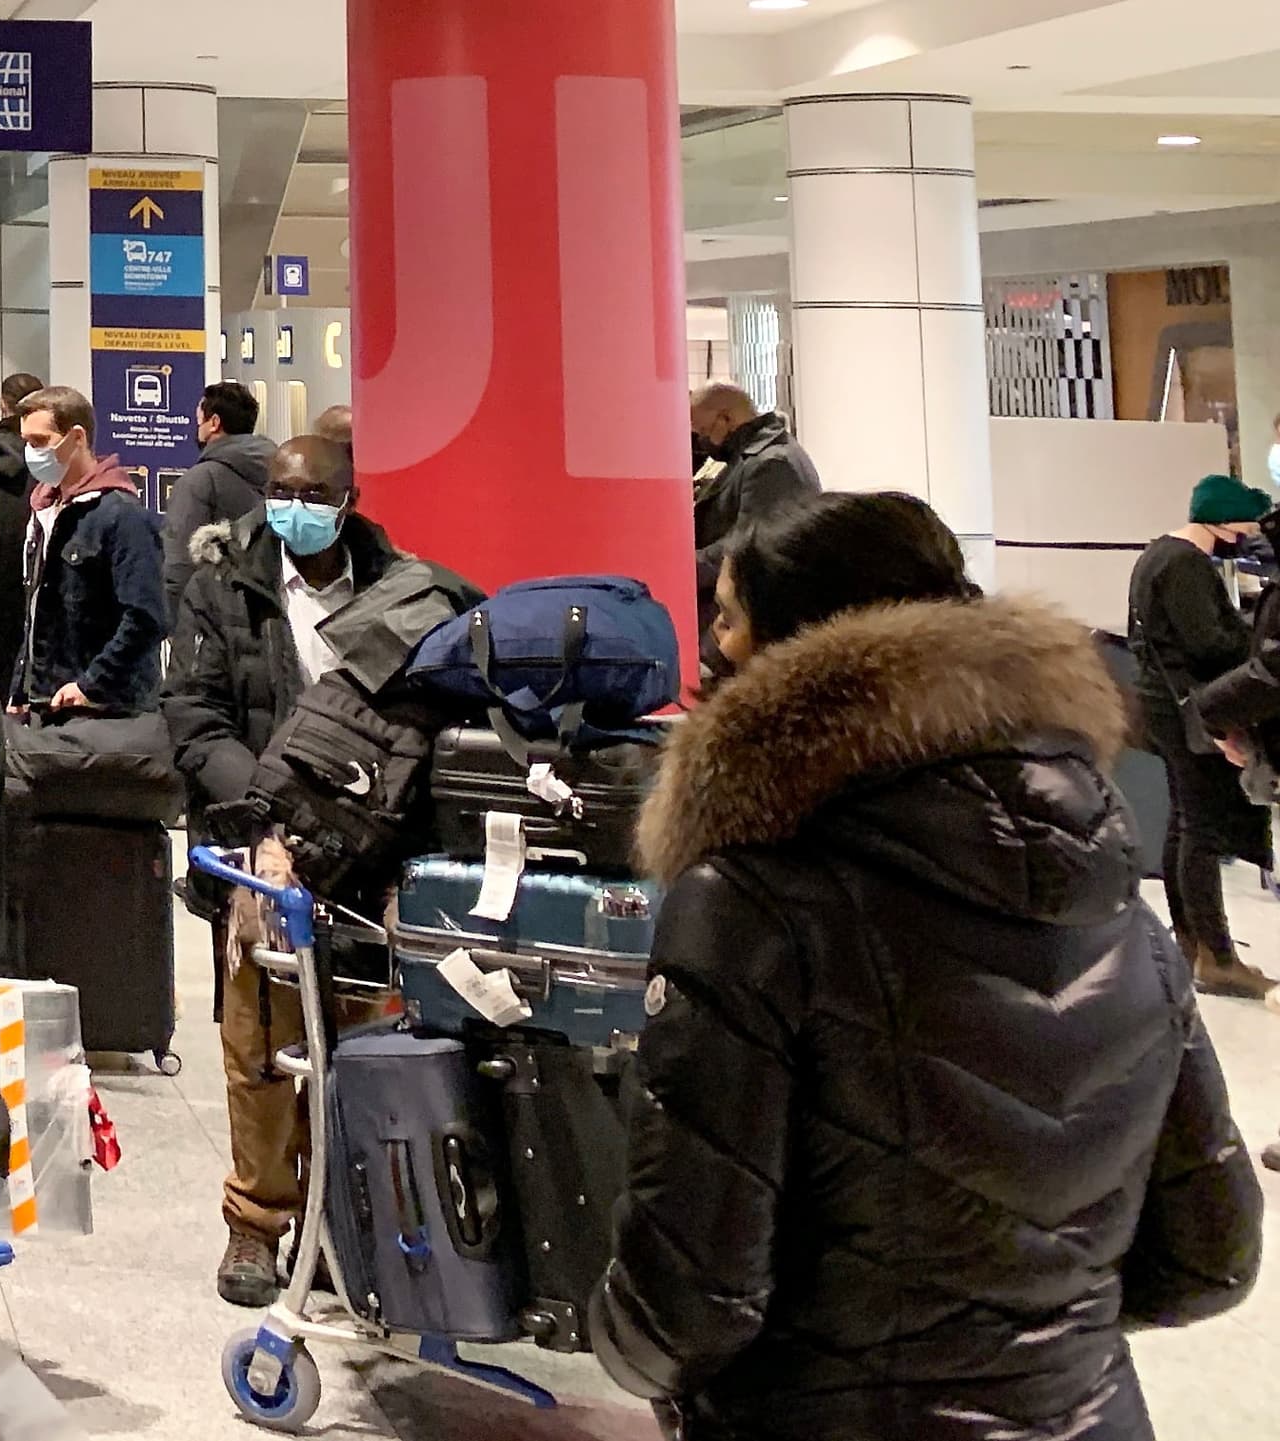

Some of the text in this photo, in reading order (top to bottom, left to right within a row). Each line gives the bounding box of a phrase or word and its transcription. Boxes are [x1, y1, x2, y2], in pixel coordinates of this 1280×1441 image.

[147, 251, 173, 263] 747
[110, 413, 147, 423] Navette
[156, 413, 190, 425] Shuttle
